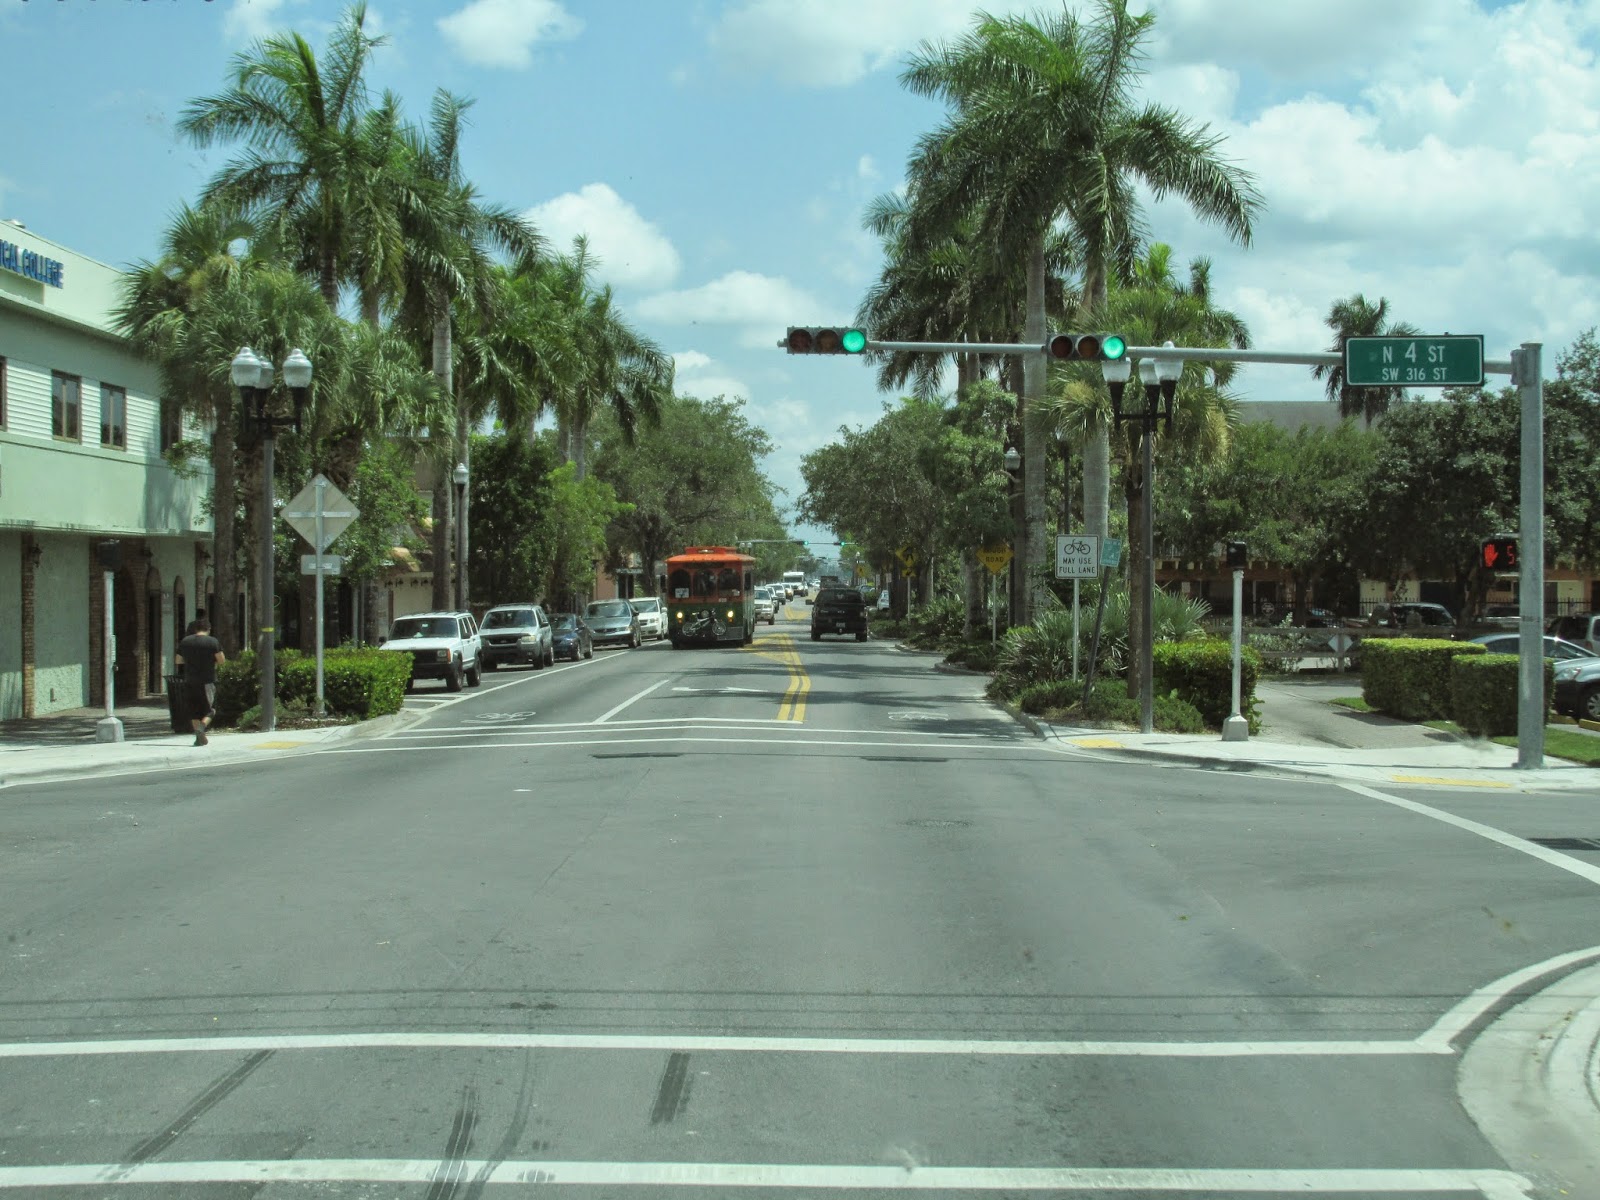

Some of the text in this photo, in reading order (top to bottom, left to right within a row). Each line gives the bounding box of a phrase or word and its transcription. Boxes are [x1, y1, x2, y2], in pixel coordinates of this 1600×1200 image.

[23, 248, 64, 290] COLLEGE
[1382, 342, 1446, 363] N 4 ST
[1381, 367, 1448, 381] SW 316 ST
[1062, 557, 1092, 565] MAY USE
[1506, 545, 1515, 565] 5
[1059, 566, 1095, 574] FULL LANE
